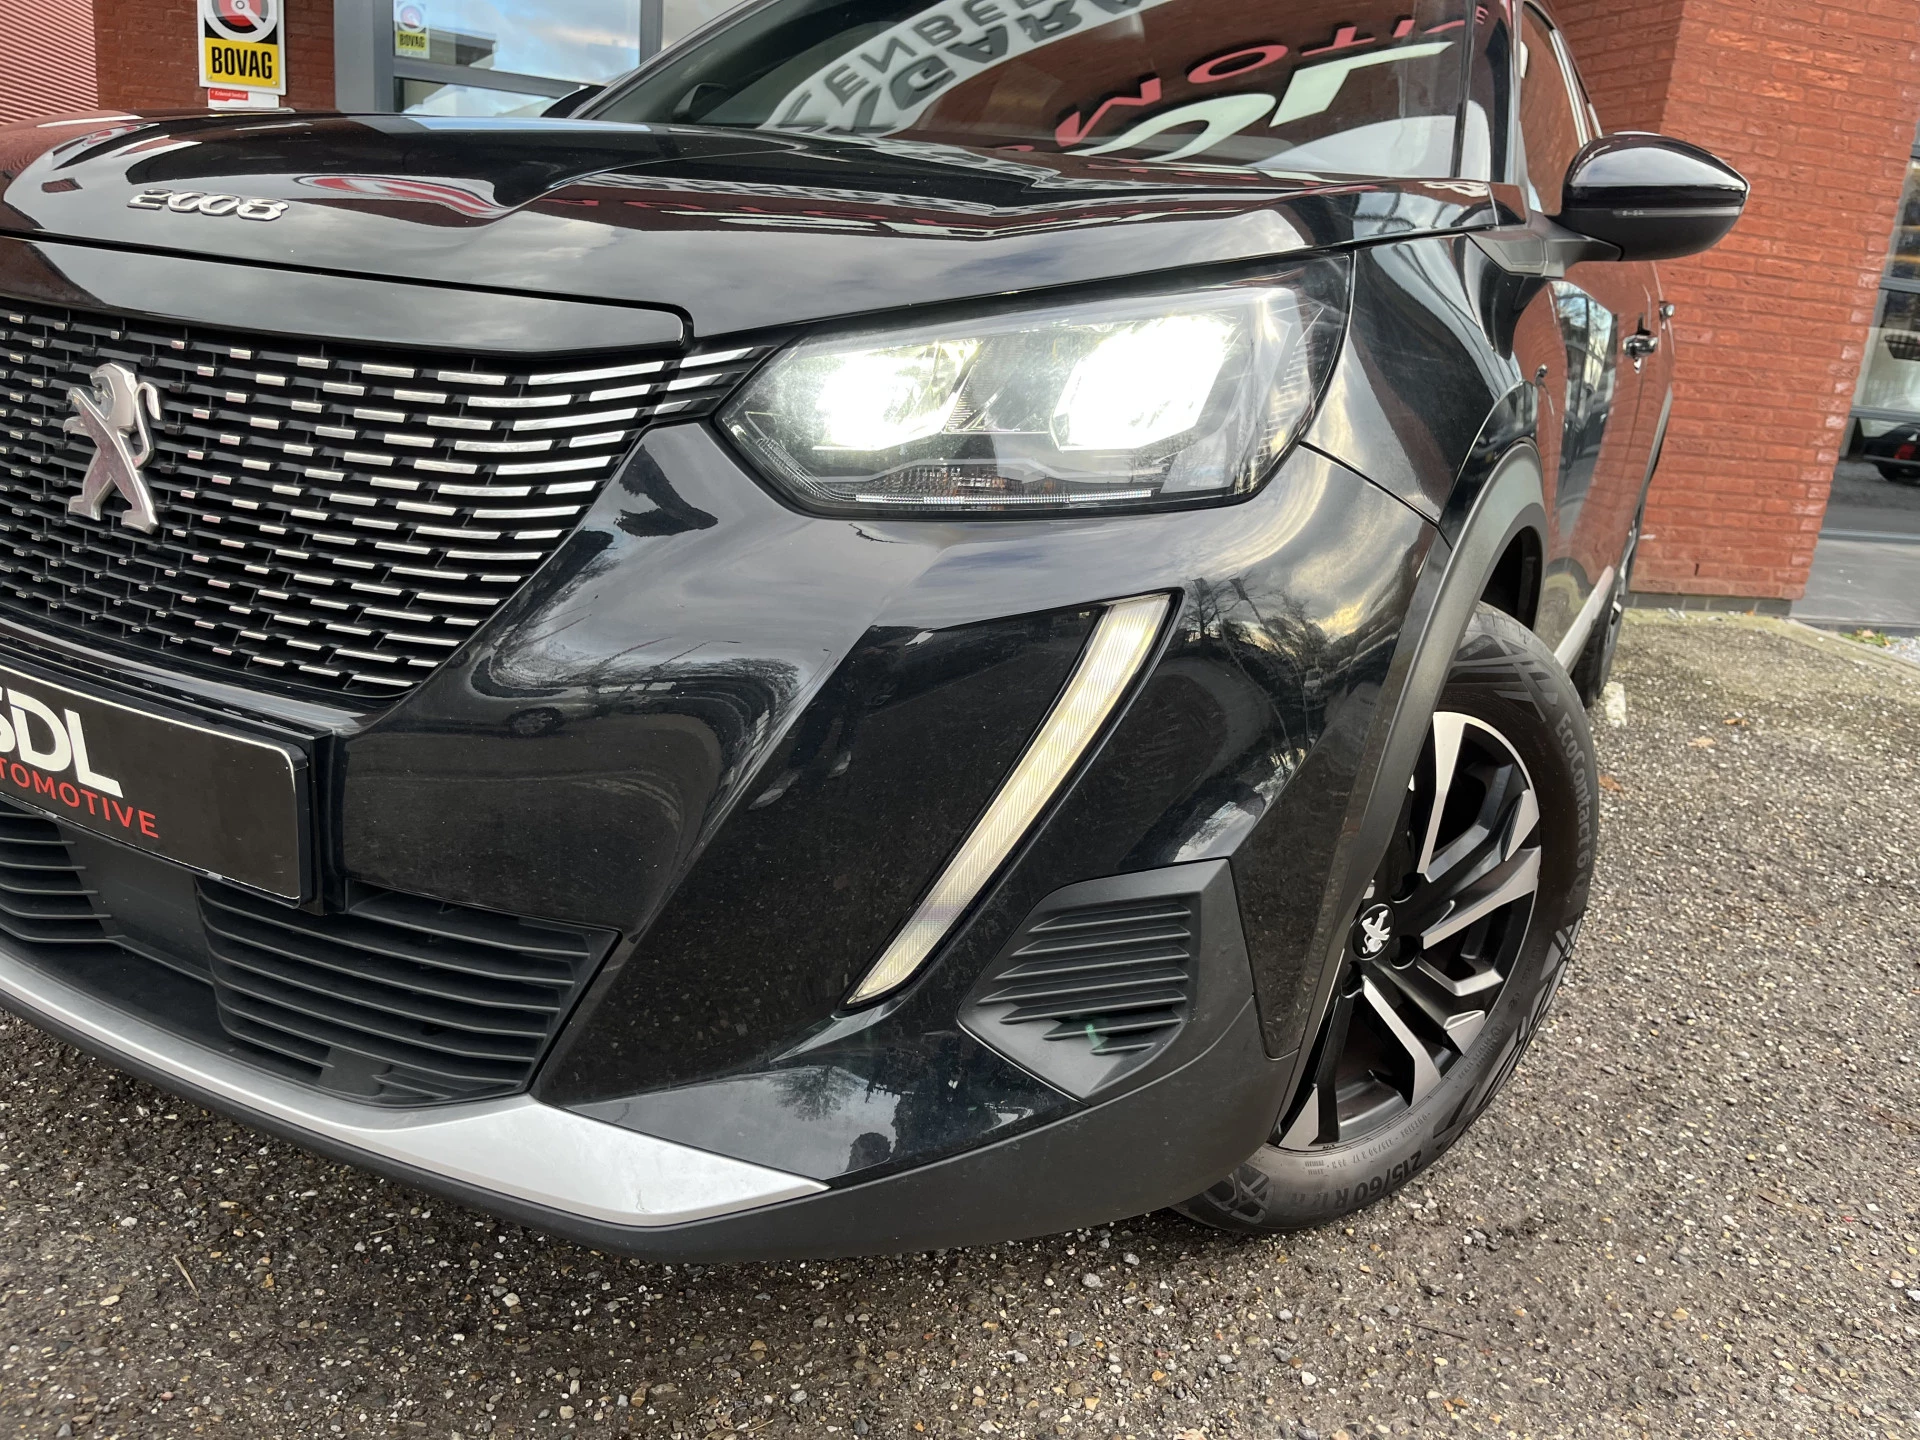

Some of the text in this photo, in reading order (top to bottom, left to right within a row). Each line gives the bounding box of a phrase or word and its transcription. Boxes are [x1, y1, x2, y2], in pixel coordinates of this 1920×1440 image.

[400, 33, 425, 48] BOVAG
[211, 46, 272, 79] BOVAG
[127, 188, 289, 221] 2008
[1555, 712, 1592, 848] EcoContact
[1354, 1150, 1423, 1202] 215/60
